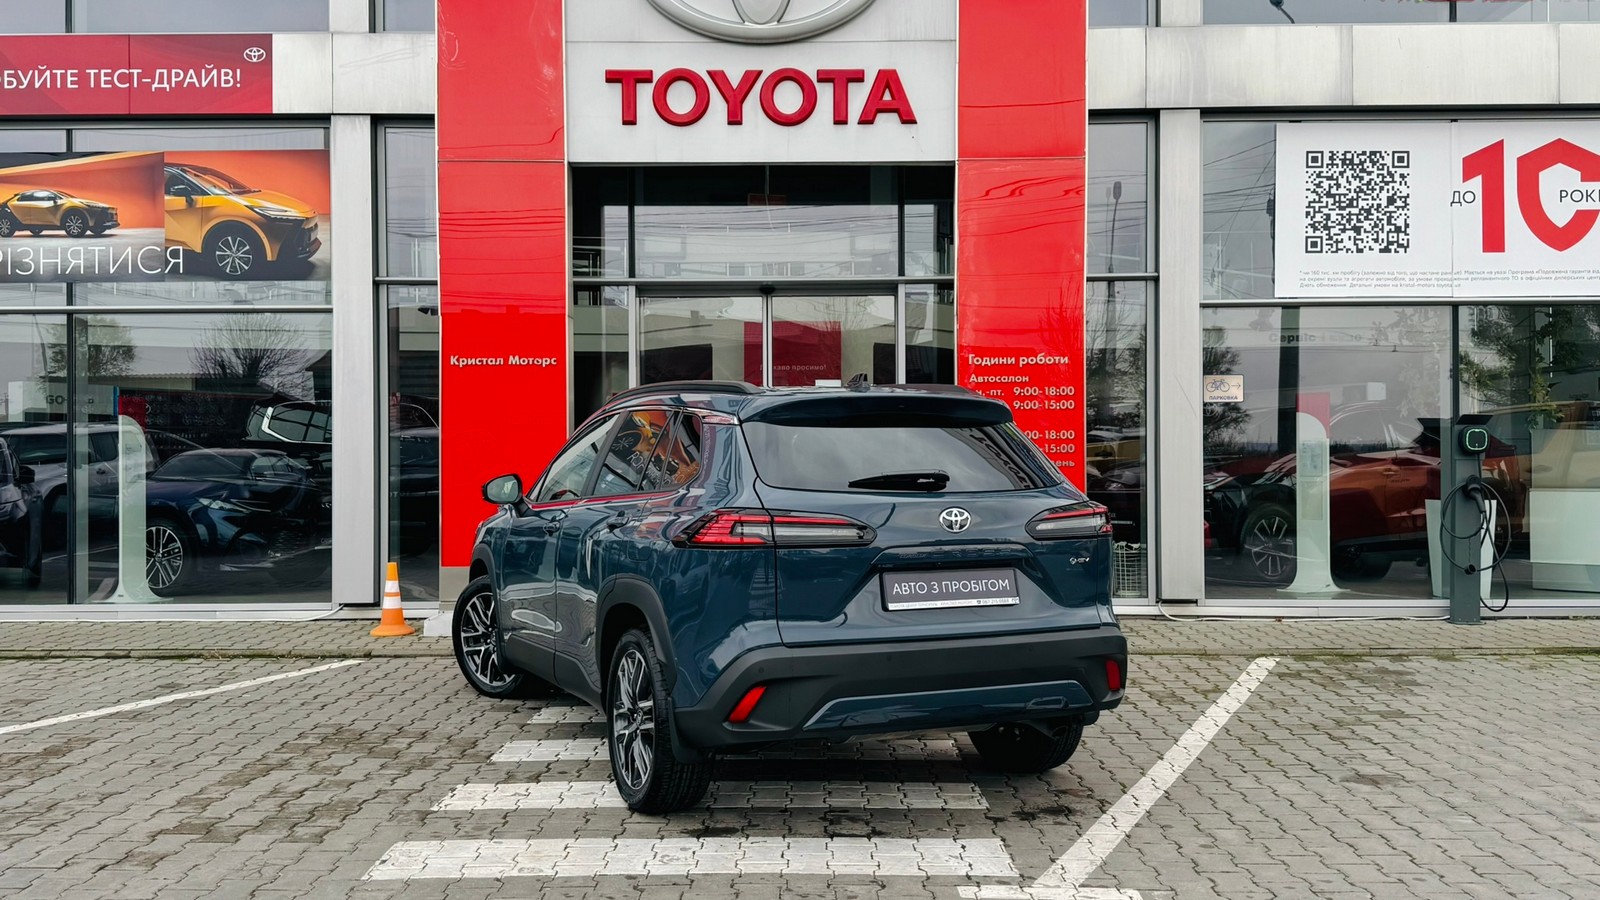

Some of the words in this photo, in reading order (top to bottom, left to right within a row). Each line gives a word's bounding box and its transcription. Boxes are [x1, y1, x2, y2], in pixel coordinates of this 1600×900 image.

[0, 65, 79, 89] БУЙТЕ
[86, 64, 241, 92] ТЕСТ-ДРАЙВ!
[605, 67, 917, 127] TOYOTA
[1450, 190, 1476, 207] ДО
[0, 246, 183, 276] ІЗНЯТИСЯ
[450, 355, 504, 367] Кристал
[508, 355, 557, 367] Моторс
[968, 354, 1015, 366] Години
[1019, 353, 1069, 367] роботи
[969, 373, 1029, 383] Автосалон
[1013, 386, 1075, 396] 9:00-18:00
[1013, 400, 1075, 410] 9:00-15:00
[1024, 430, 1075, 440] 00-18:00
[892, 580, 928, 595] АВТО
[931, 580, 939, 594] З
[942, 578, 1010, 593] ПРОБІГОМ
